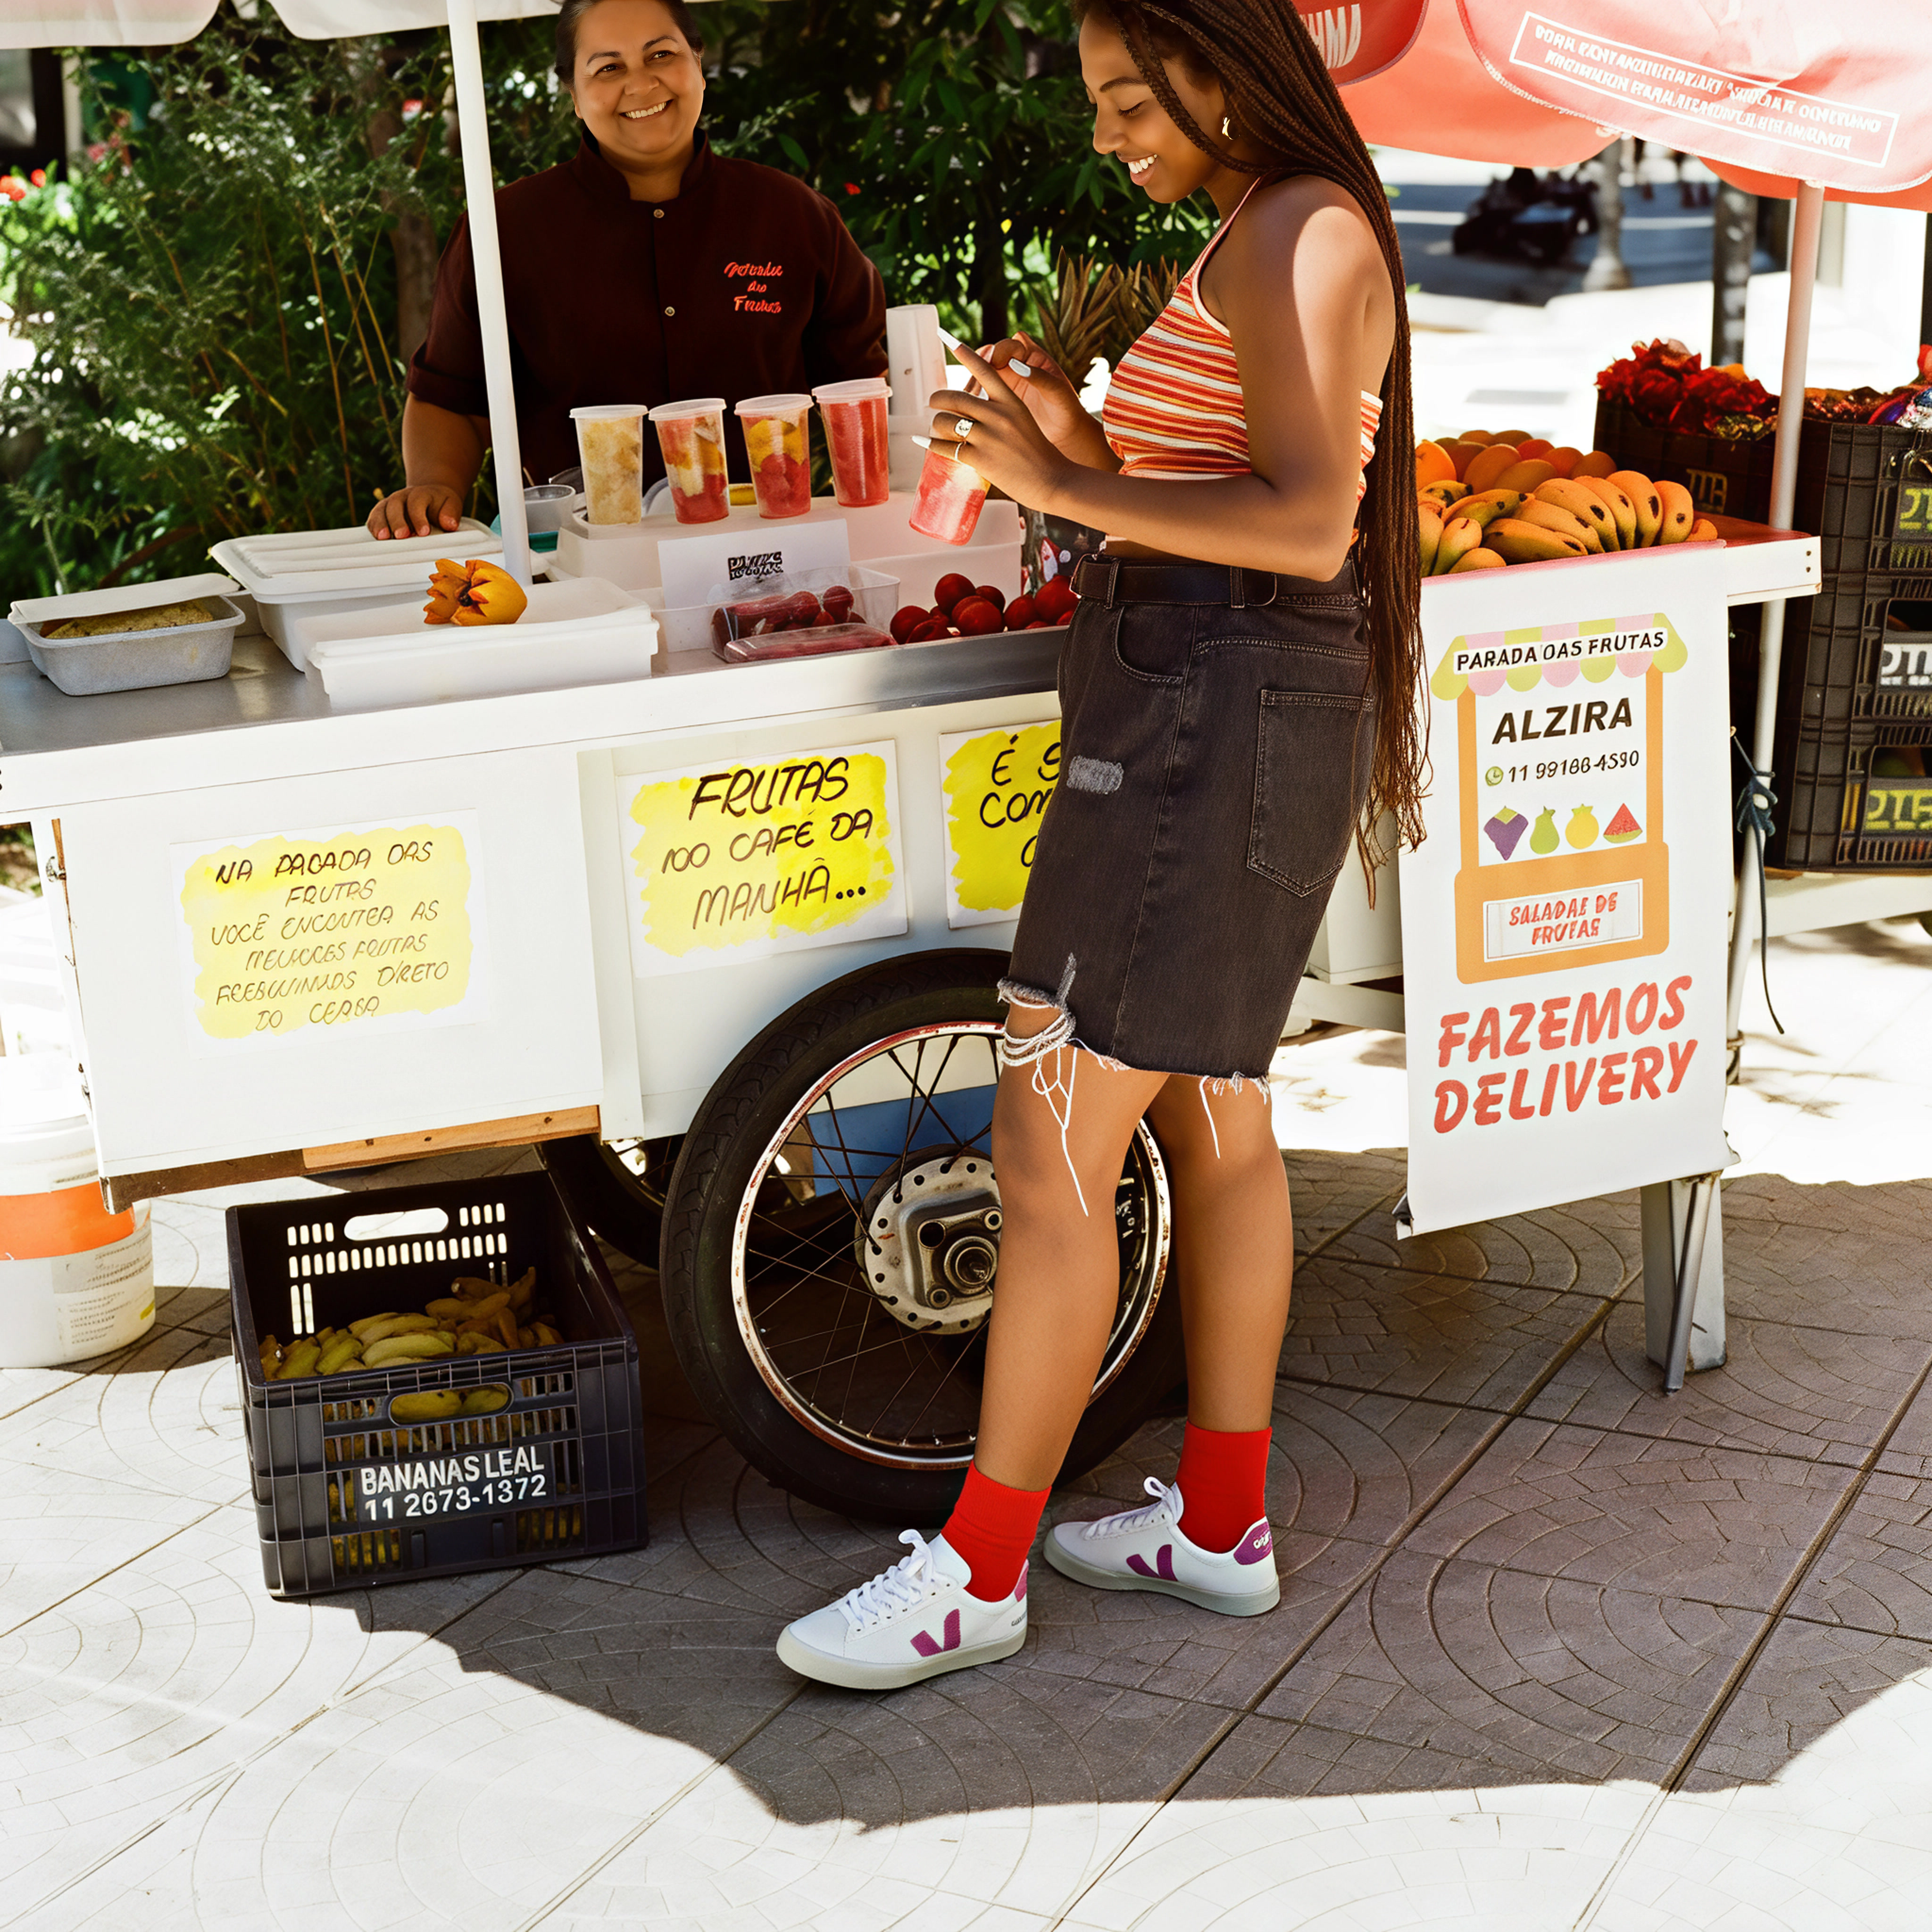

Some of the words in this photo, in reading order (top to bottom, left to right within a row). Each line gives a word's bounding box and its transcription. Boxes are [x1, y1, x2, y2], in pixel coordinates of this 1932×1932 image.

[1457, 646, 1538, 671] PARADA
[1588, 631, 1665, 655] FRUTAS
[1491, 697, 1633, 745] ALZIRA
[689, 757, 849, 820] FRUTAS
[1508, 765, 1528, 783] 11
[830, 808, 873, 841] DA
[410, 899, 440, 921] AS
[1438, 974, 1693, 1068] FAZEMOS
[1433, 1039, 1699, 1134] DELIVERY
[360, 1455, 480, 1496] BANANAS
[484, 1446, 545, 1479] LEAL
[365, 1496, 394, 1521] 11
